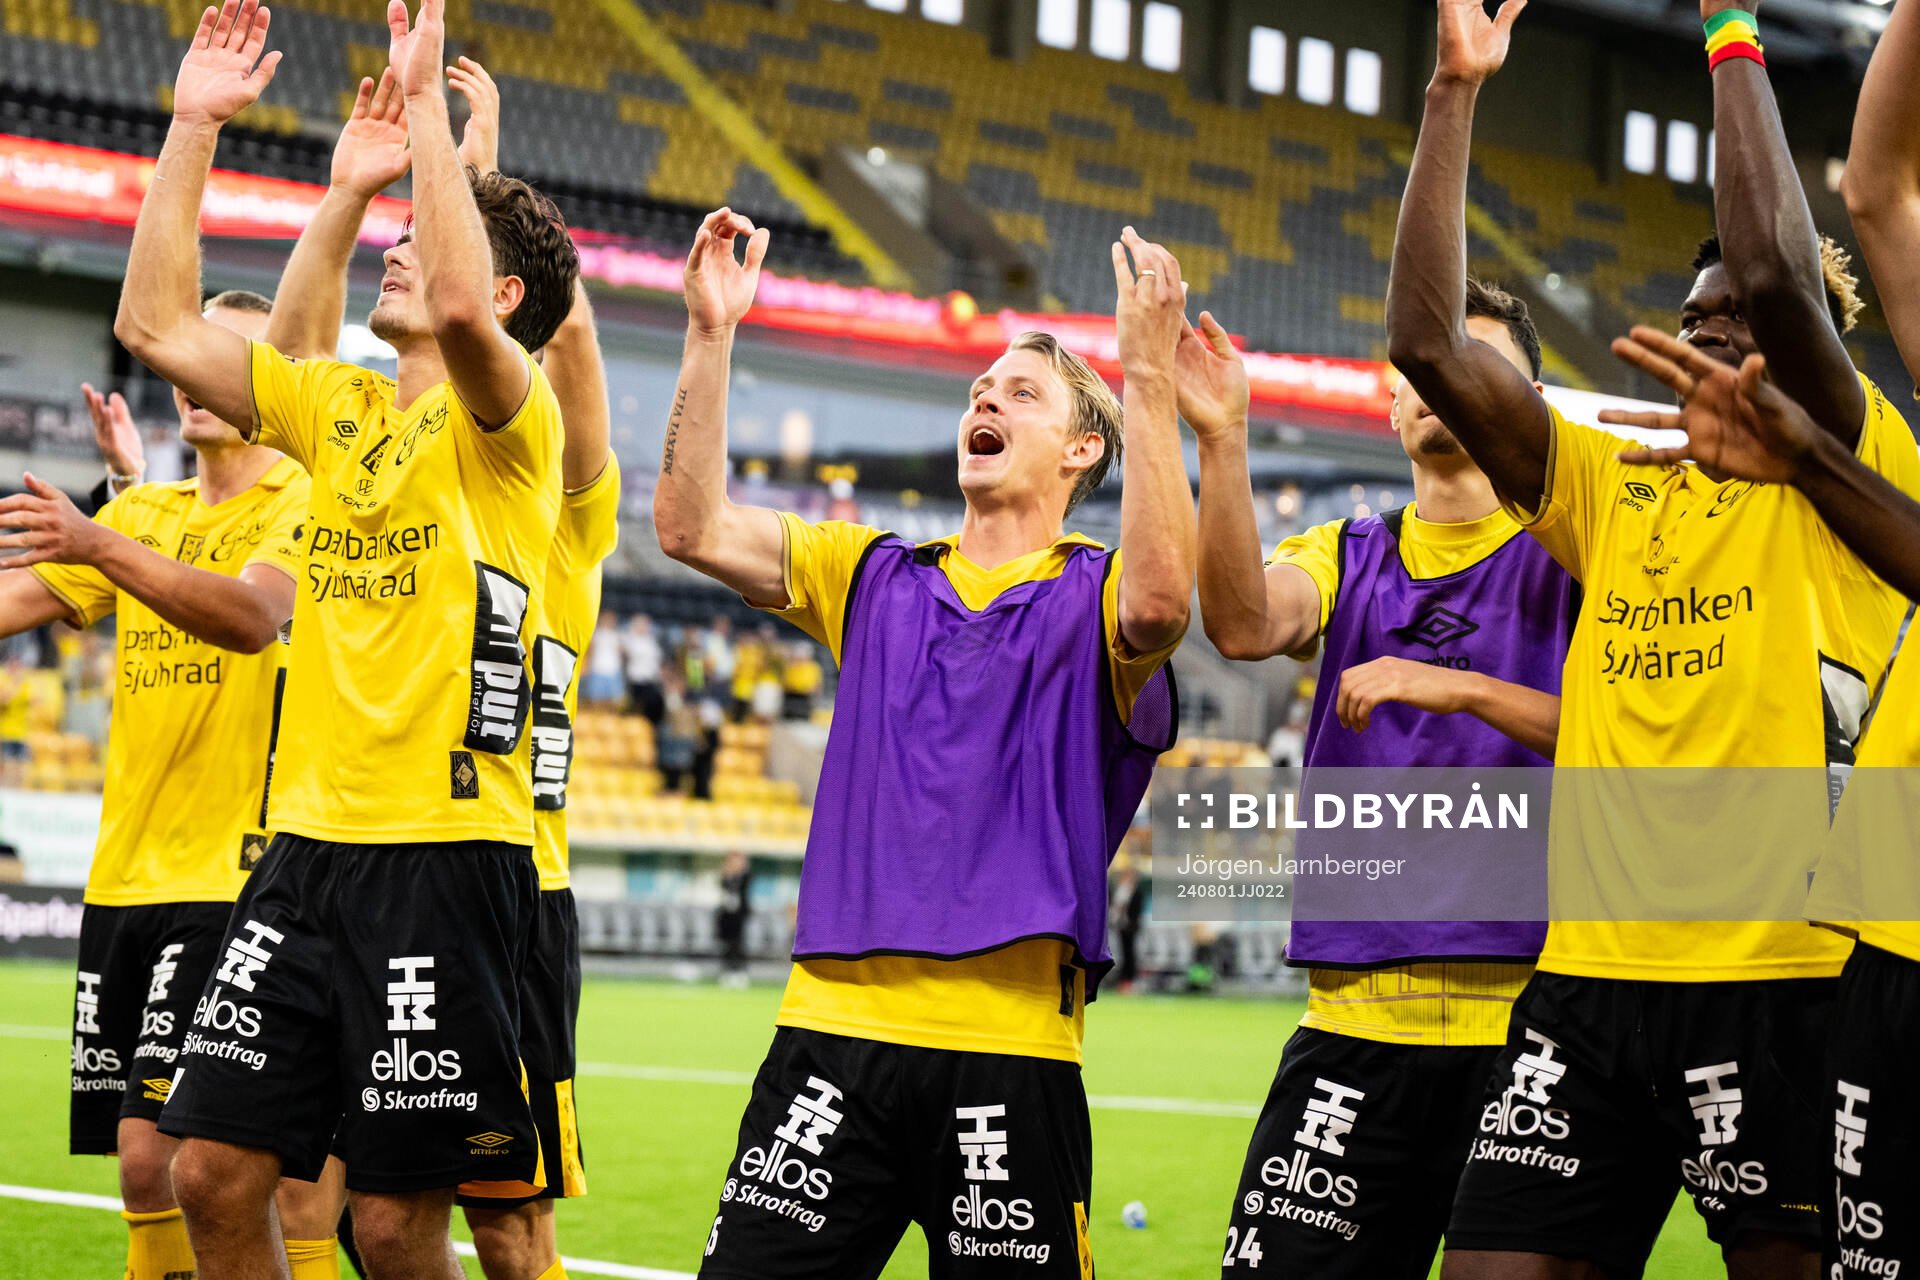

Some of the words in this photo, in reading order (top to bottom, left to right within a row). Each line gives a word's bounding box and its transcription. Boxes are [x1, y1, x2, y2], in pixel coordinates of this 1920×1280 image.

[327, 435, 350, 451] umbro
[193, 986, 263, 1038] ellos
[192, 1034, 268, 1071] Skrotfrag
[371, 1037, 462, 1082] ellos
[384, 1088, 478, 1111] Skrotfrag
[1480, 1090, 1571, 1140] ellos
[739, 1140, 834, 1201] ellos
[1261, 1149, 1358, 1208] ellos
[1475, 1138, 1581, 1177] Skrotfrag
[1681, 1149, 1768, 1195] ellos
[735, 1183, 827, 1233] Skrotfrag
[952, 1184, 1035, 1231] ellos
[1267, 1196, 1361, 1241] Skrotfrag
[963, 1236, 1051, 1265] Skrotfrag
[1222, 1227, 1263, 1268] 24
